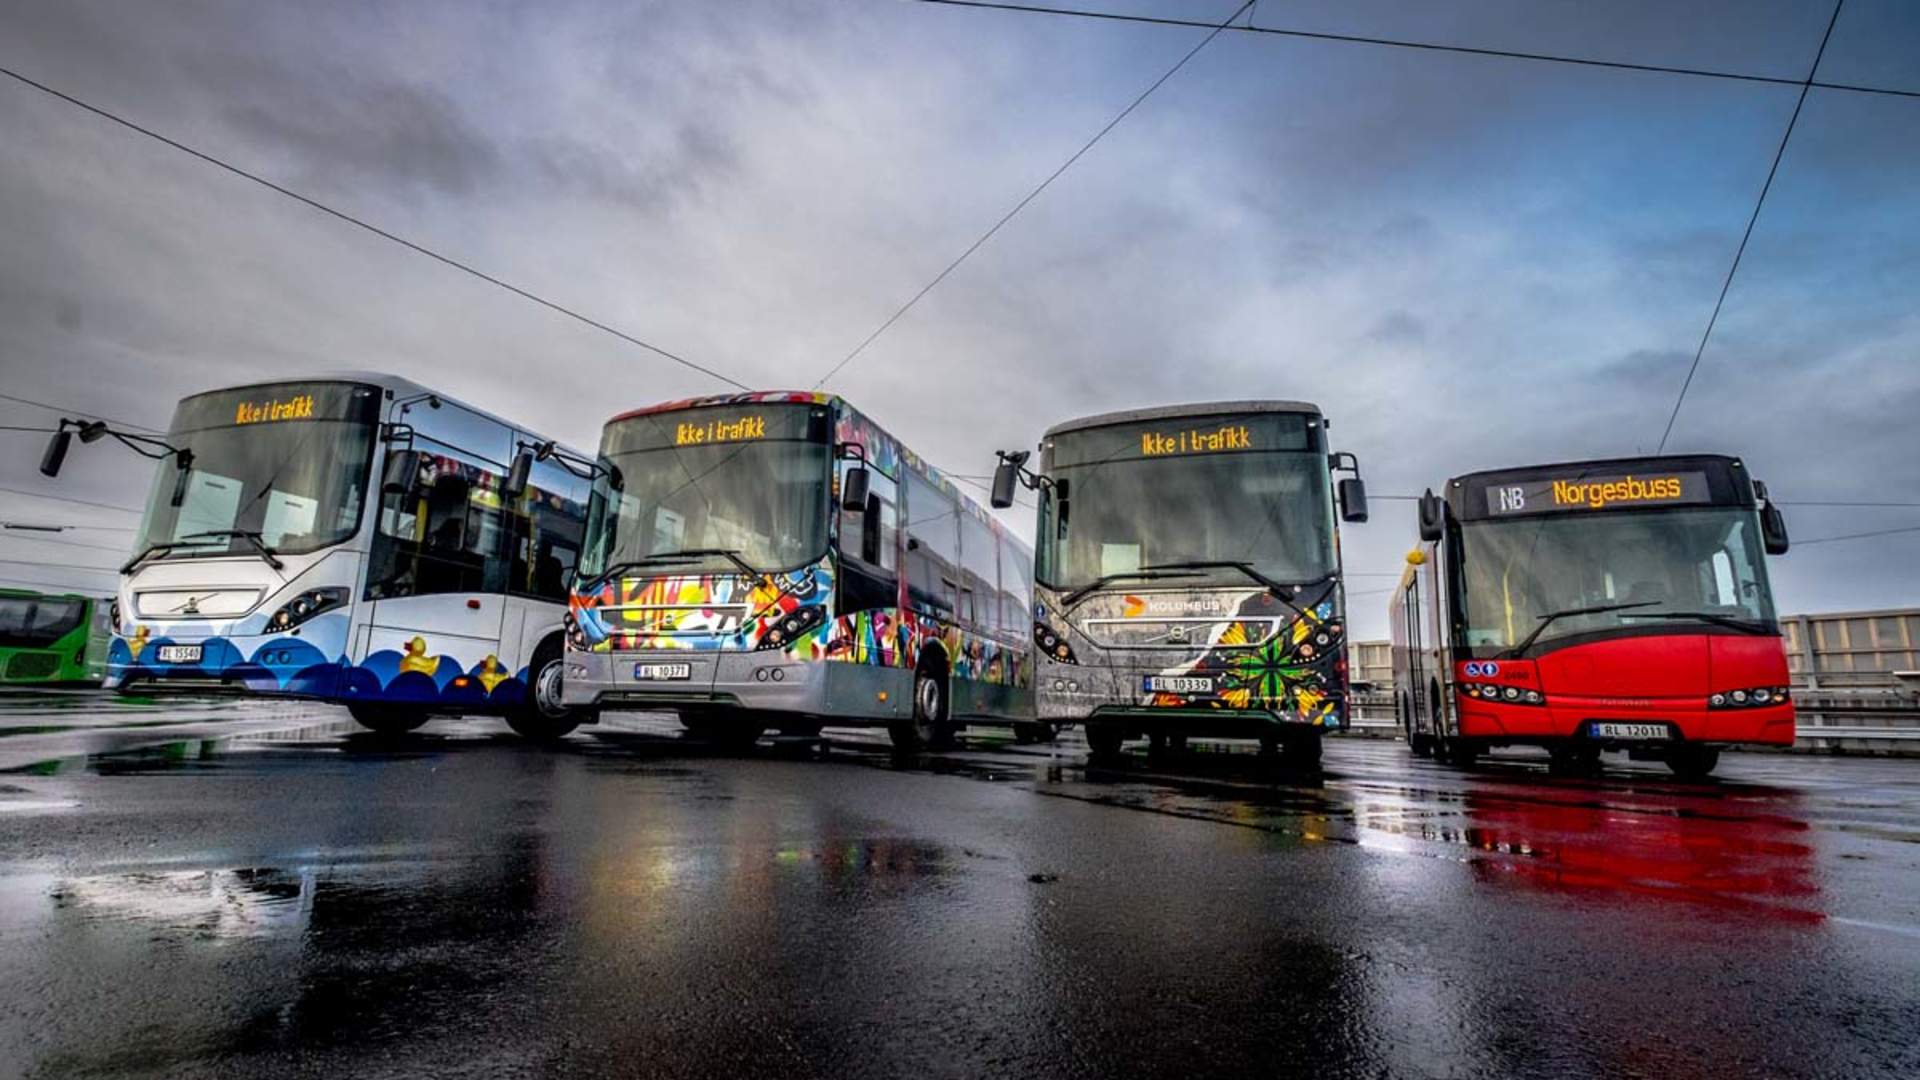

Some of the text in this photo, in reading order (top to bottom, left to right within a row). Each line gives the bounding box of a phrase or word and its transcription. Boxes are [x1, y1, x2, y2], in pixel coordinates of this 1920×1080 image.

[236, 395, 313, 424] Ikke i trafikk
[676, 416, 766, 445] Ikke i trafikk
[1143, 425, 1252, 455] Ikke i trafikk
[1499, 475, 1682, 511] NB Norgesbuss
[1173, 679, 1209, 690] 10339
[1604, 725, 1662, 737] RL 12011
